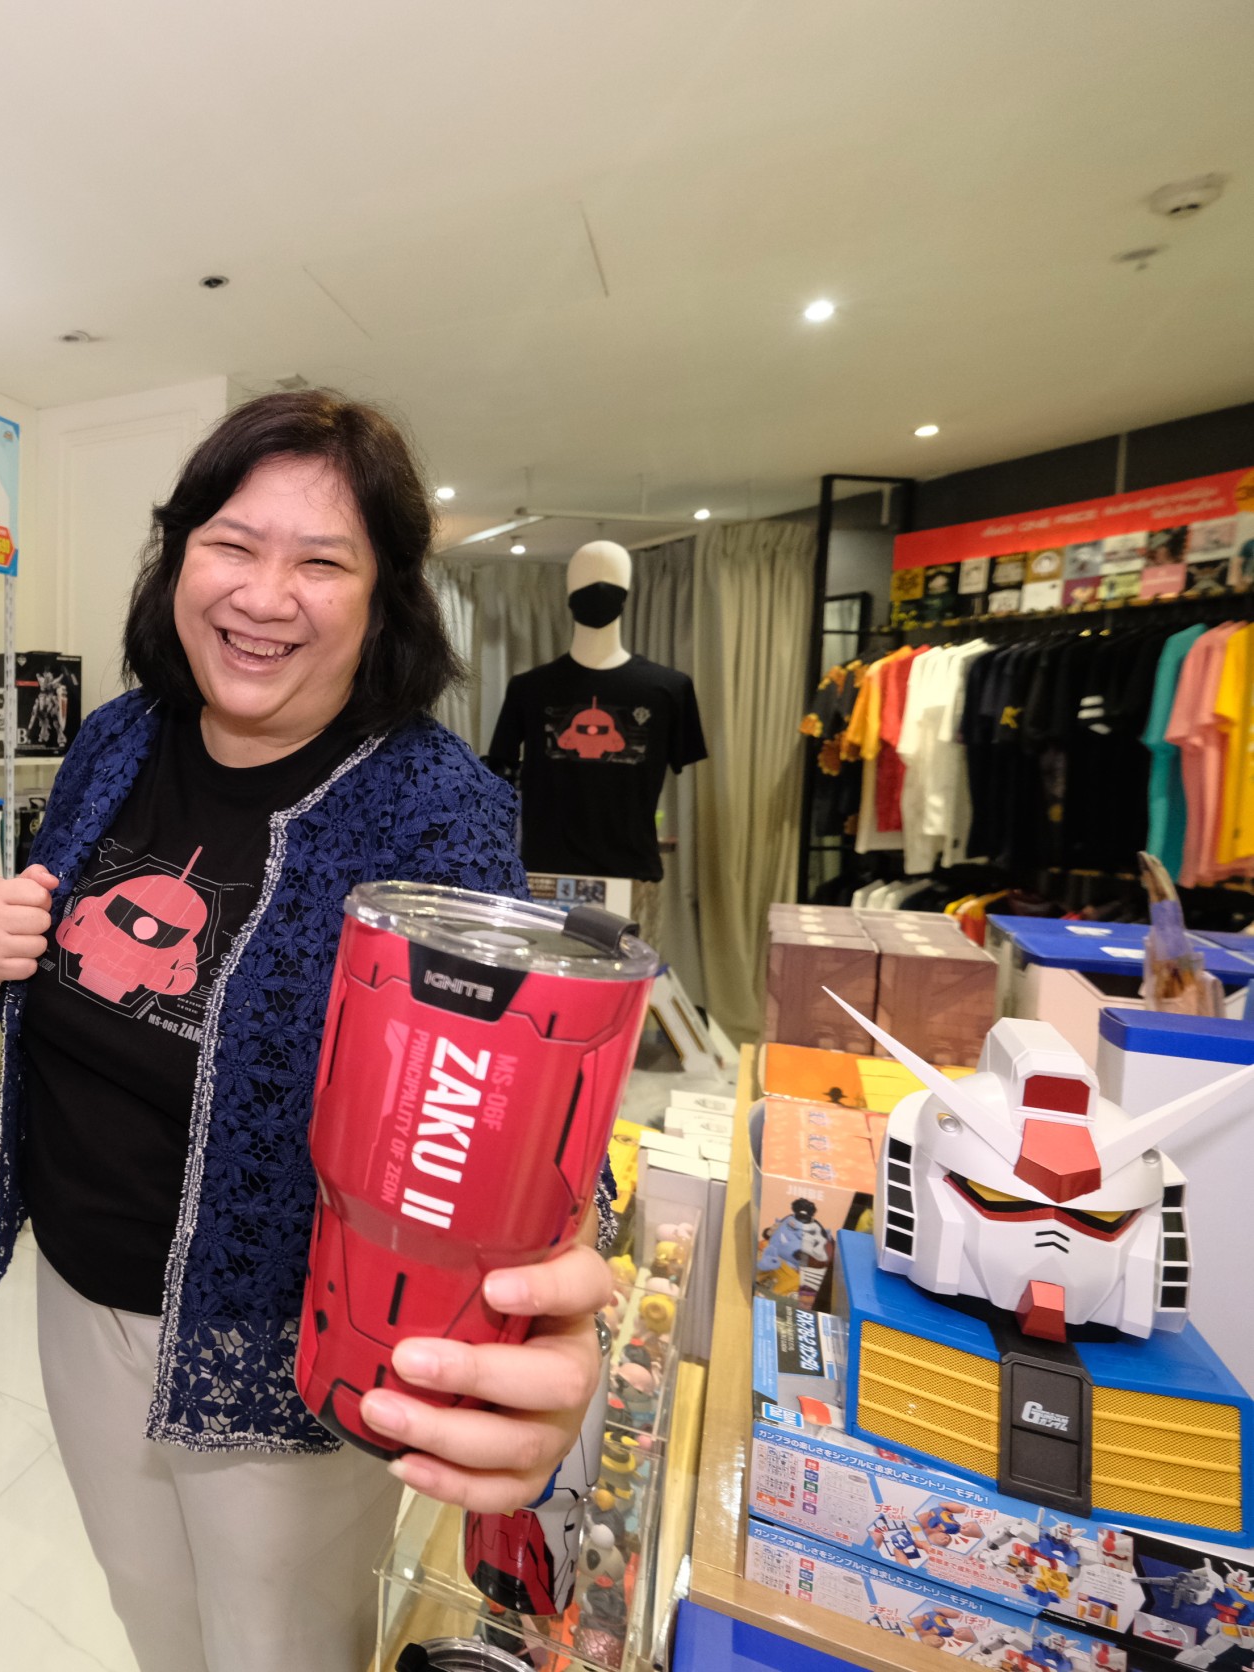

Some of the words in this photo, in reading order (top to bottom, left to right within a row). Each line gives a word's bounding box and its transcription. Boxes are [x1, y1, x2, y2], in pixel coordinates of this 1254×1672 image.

[423, 969, 494, 1002] IGNITE
[147, 1013, 179, 1034] MS-06S
[394, 1028, 430, 1136] PRINCIPALITY
[481, 1052, 519, 1132] MS-06F
[411, 1035, 491, 1184] ZAKU
[389, 1136, 407, 1161] OF
[381, 1161, 404, 1205] ZEON
[401, 1187, 455, 1230] II
